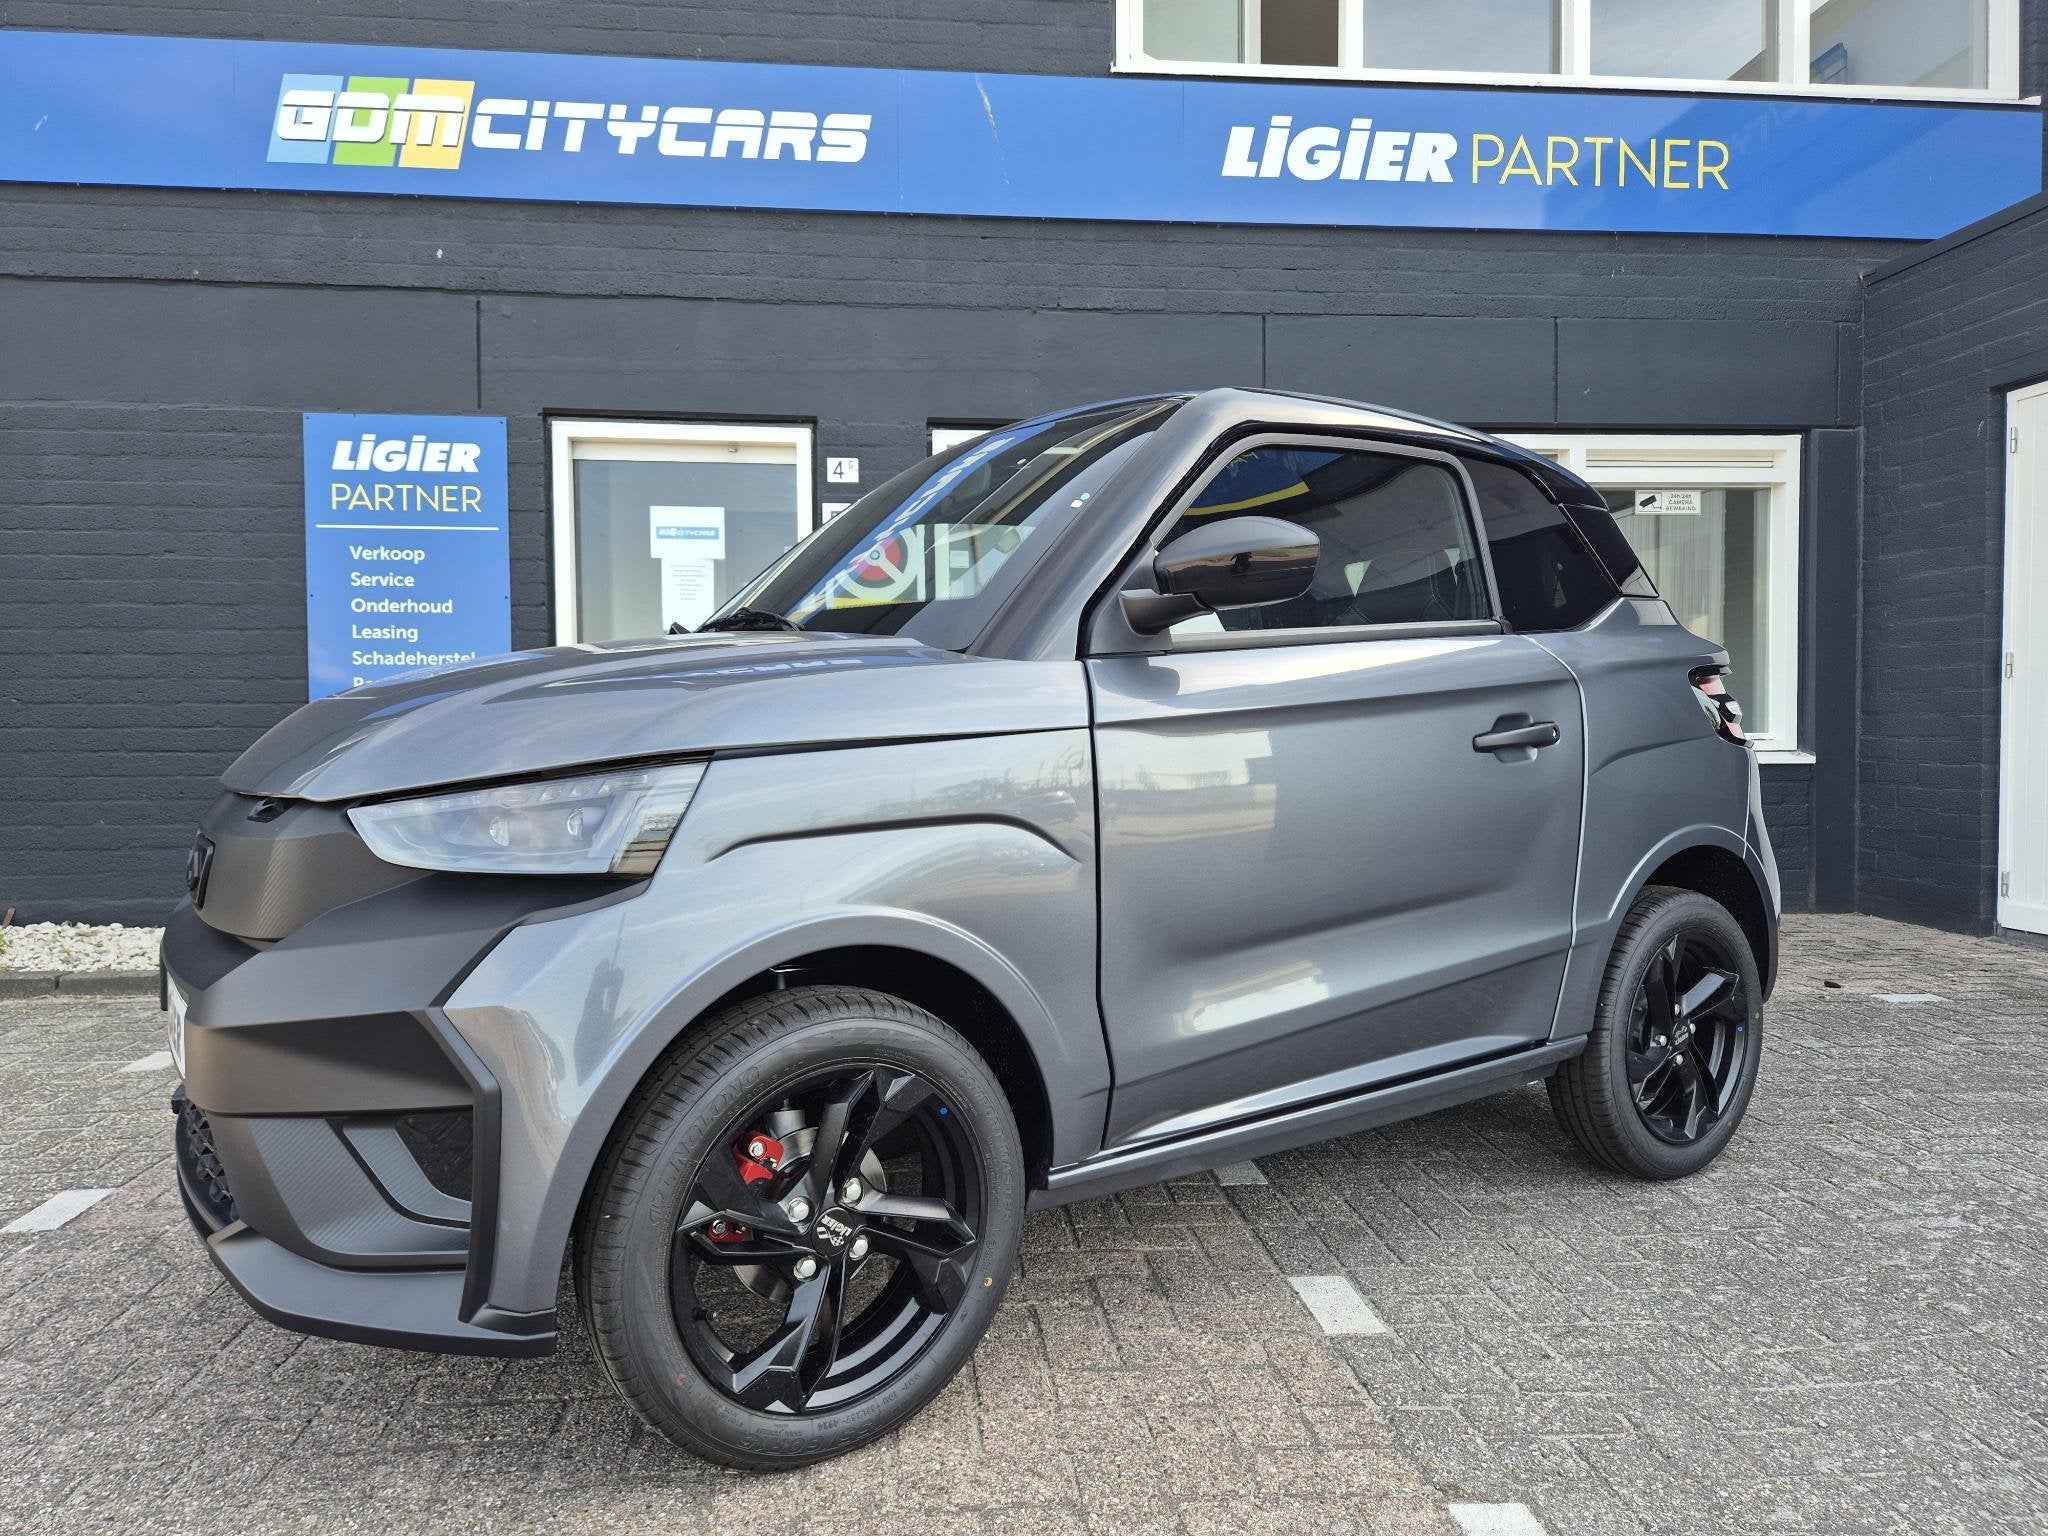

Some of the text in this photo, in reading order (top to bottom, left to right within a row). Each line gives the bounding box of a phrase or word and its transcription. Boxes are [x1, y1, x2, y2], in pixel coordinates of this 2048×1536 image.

[471, 98, 872, 163] CITYCARS
[1221, 115, 1729, 190] LIGIER PARTNER
[331, 433, 481, 473] LIGIER
[832, 460, 845, 480] 4
[331, 483, 482, 512] PARTNER
[350, 545, 426, 565] Verkoop
[350, 572, 415, 587] Service
[350, 598, 453, 614] Onderhoud
[351, 624, 418, 642] Leasing
[821, 1214, 853, 1237] LIGIER
